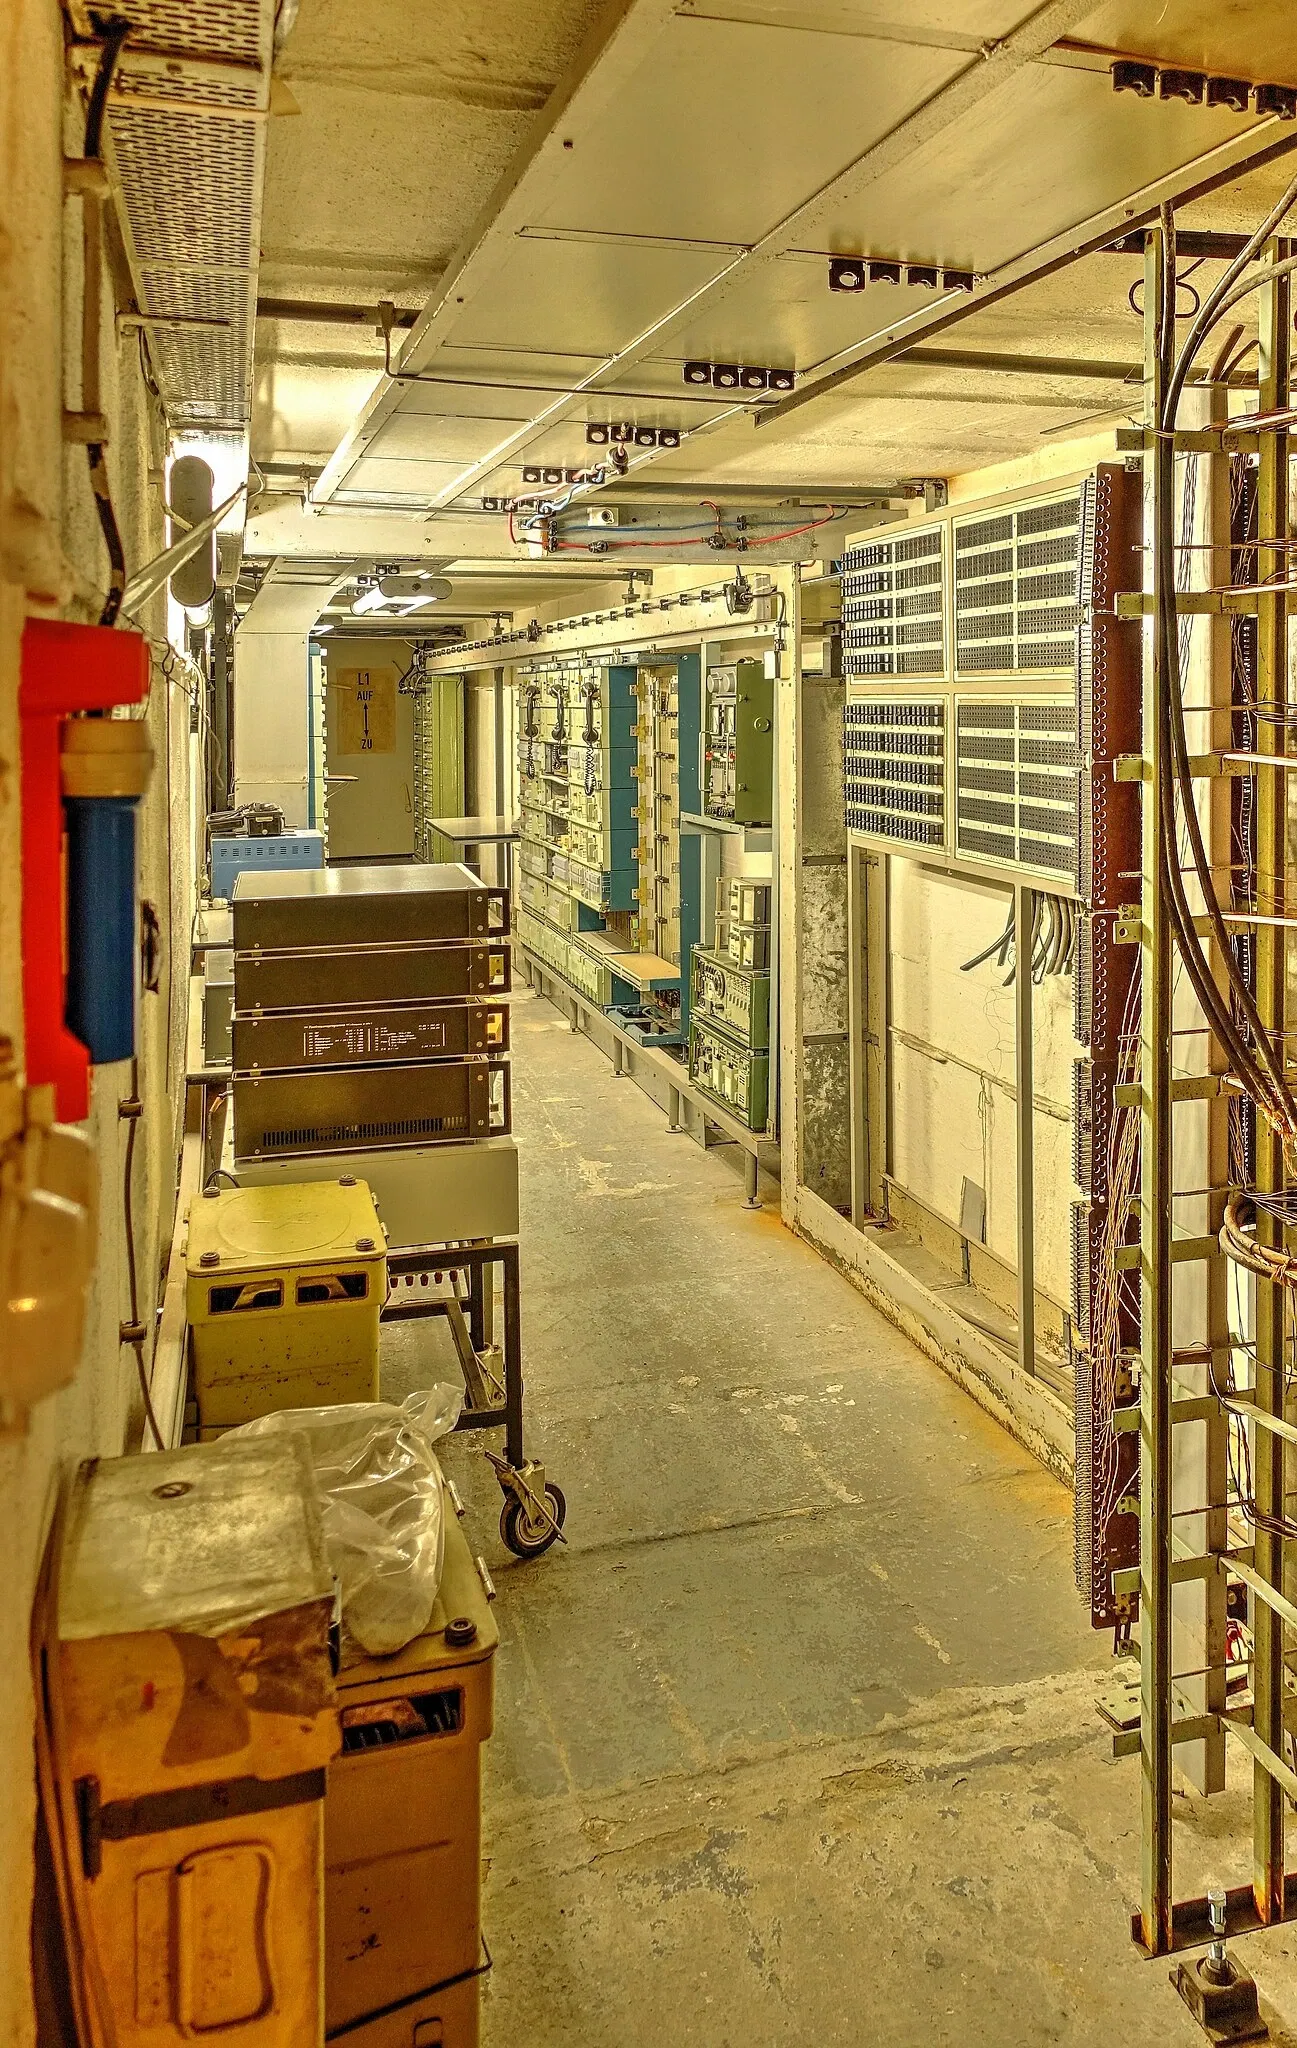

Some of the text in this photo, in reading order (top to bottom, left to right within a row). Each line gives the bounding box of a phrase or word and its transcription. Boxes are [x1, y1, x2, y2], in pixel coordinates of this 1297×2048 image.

[358, 673, 370, 685] L1
[357, 691, 373, 701] AUF
[361, 739, 372, 749] ZU
